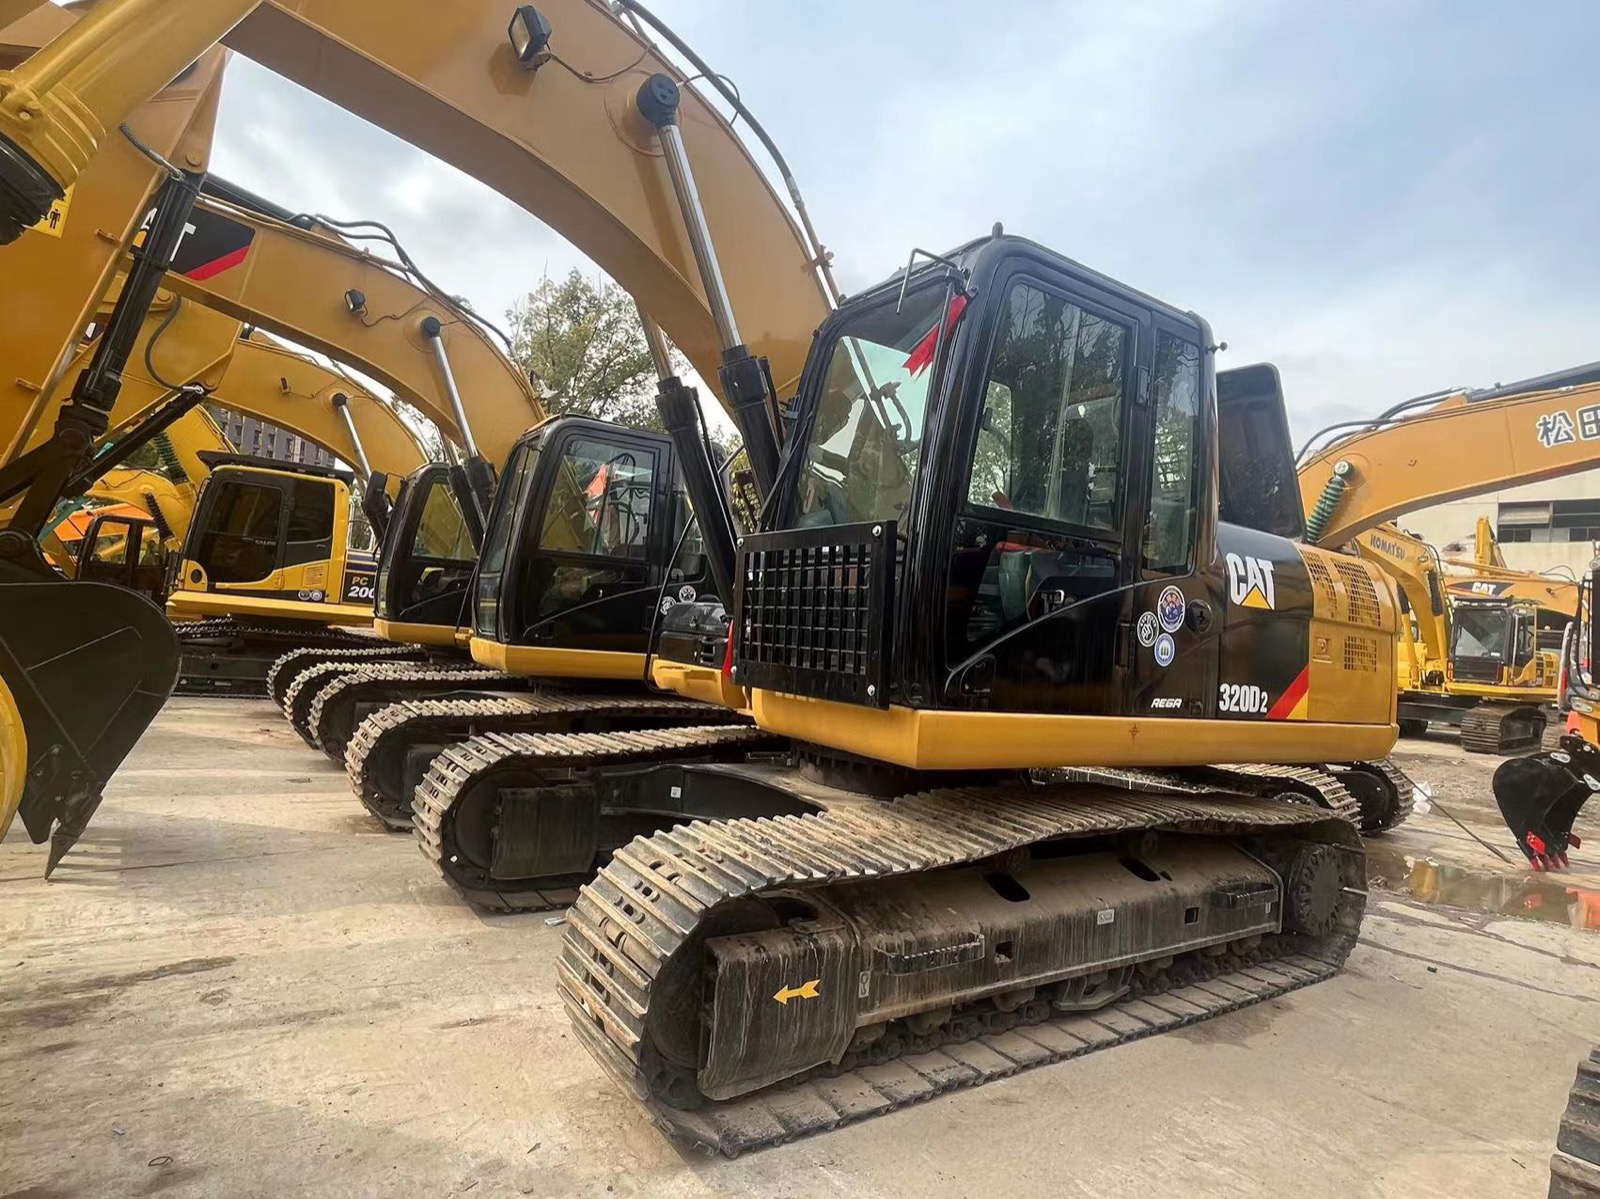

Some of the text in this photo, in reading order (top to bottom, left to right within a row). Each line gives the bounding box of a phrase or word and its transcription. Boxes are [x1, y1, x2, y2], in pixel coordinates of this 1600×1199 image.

[1370, 534, 1405, 560] KOMATSU
[351, 576, 369, 585] PC
[1226, 552, 1275, 610] CAT
[1472, 582, 1496, 595] CAT
[1151, 698, 1183, 708] REGA
[1219, 683, 1268, 713] 320D2
